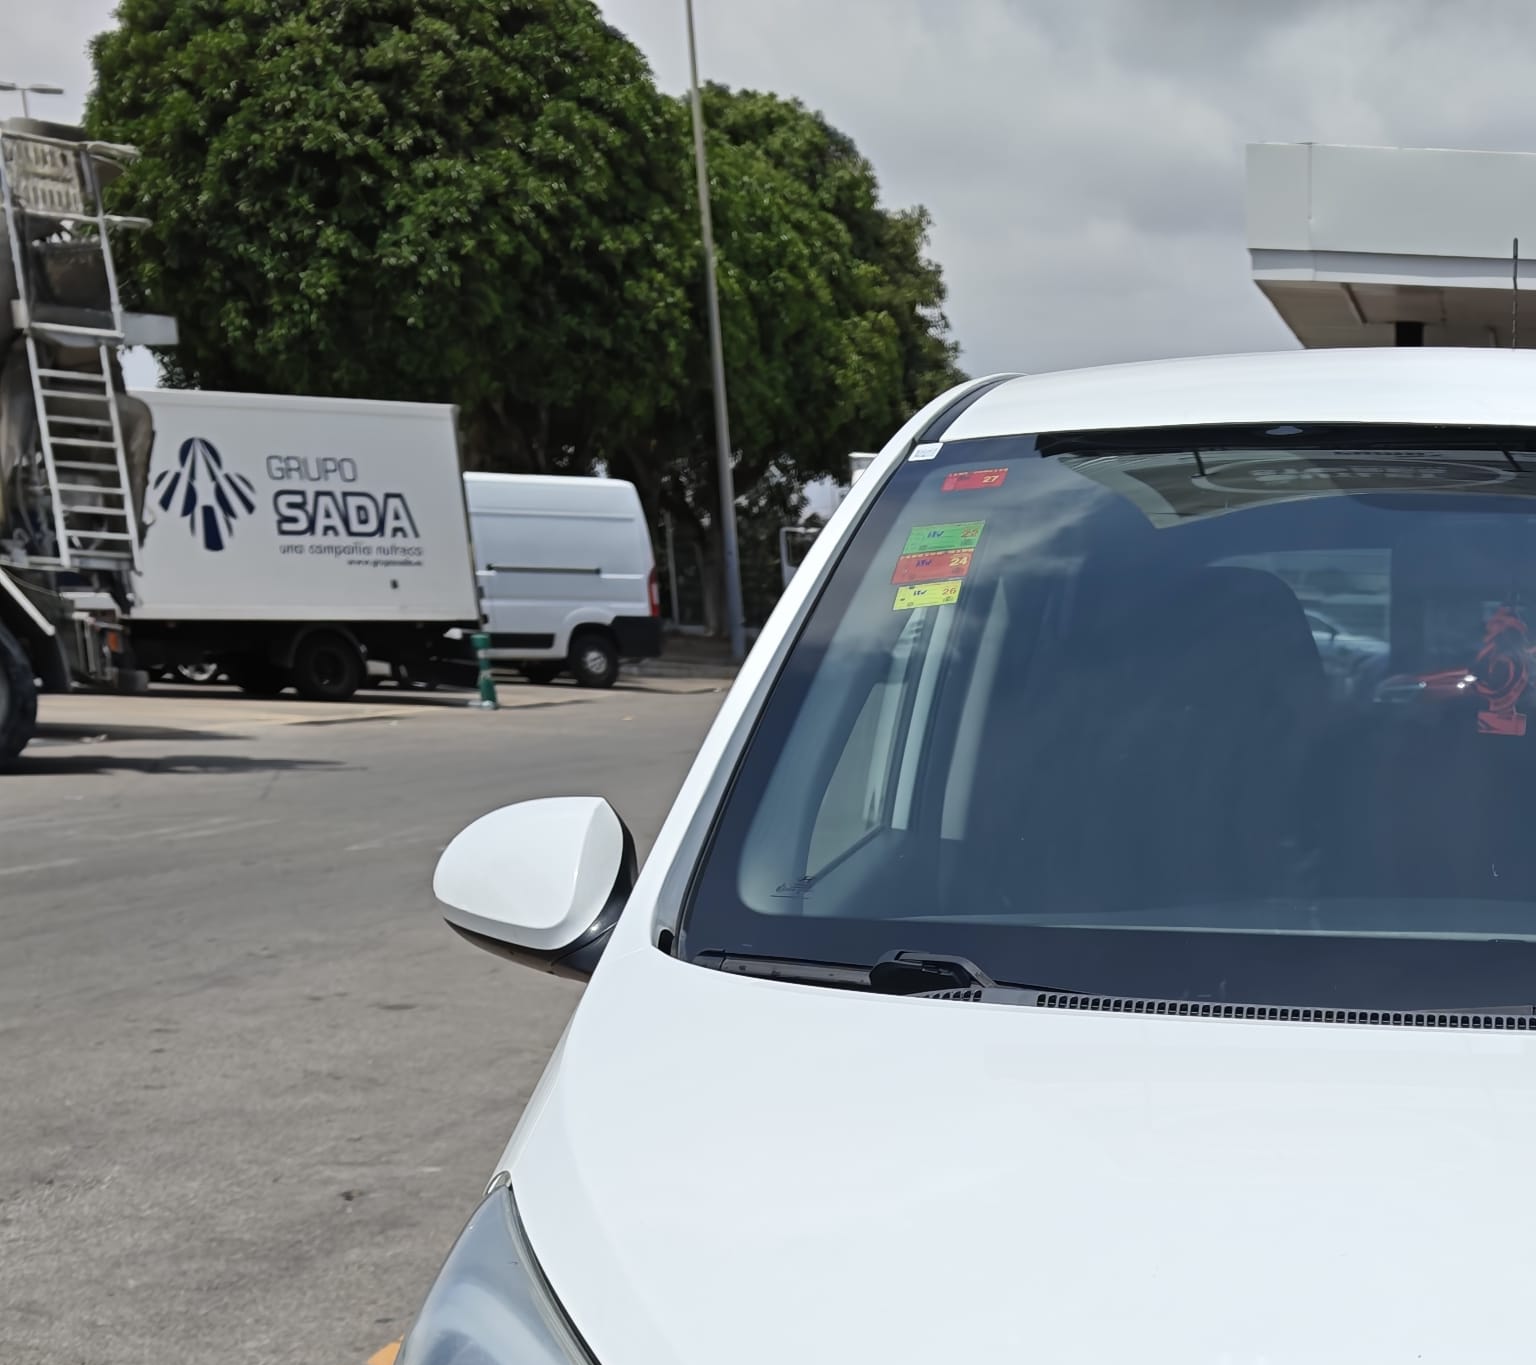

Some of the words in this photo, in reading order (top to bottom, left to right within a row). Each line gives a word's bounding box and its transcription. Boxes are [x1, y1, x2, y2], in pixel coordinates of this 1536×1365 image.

[266, 455, 358, 482] GRUPO
[273, 489, 420, 539] SADA
[950, 556, 968, 567] 24
